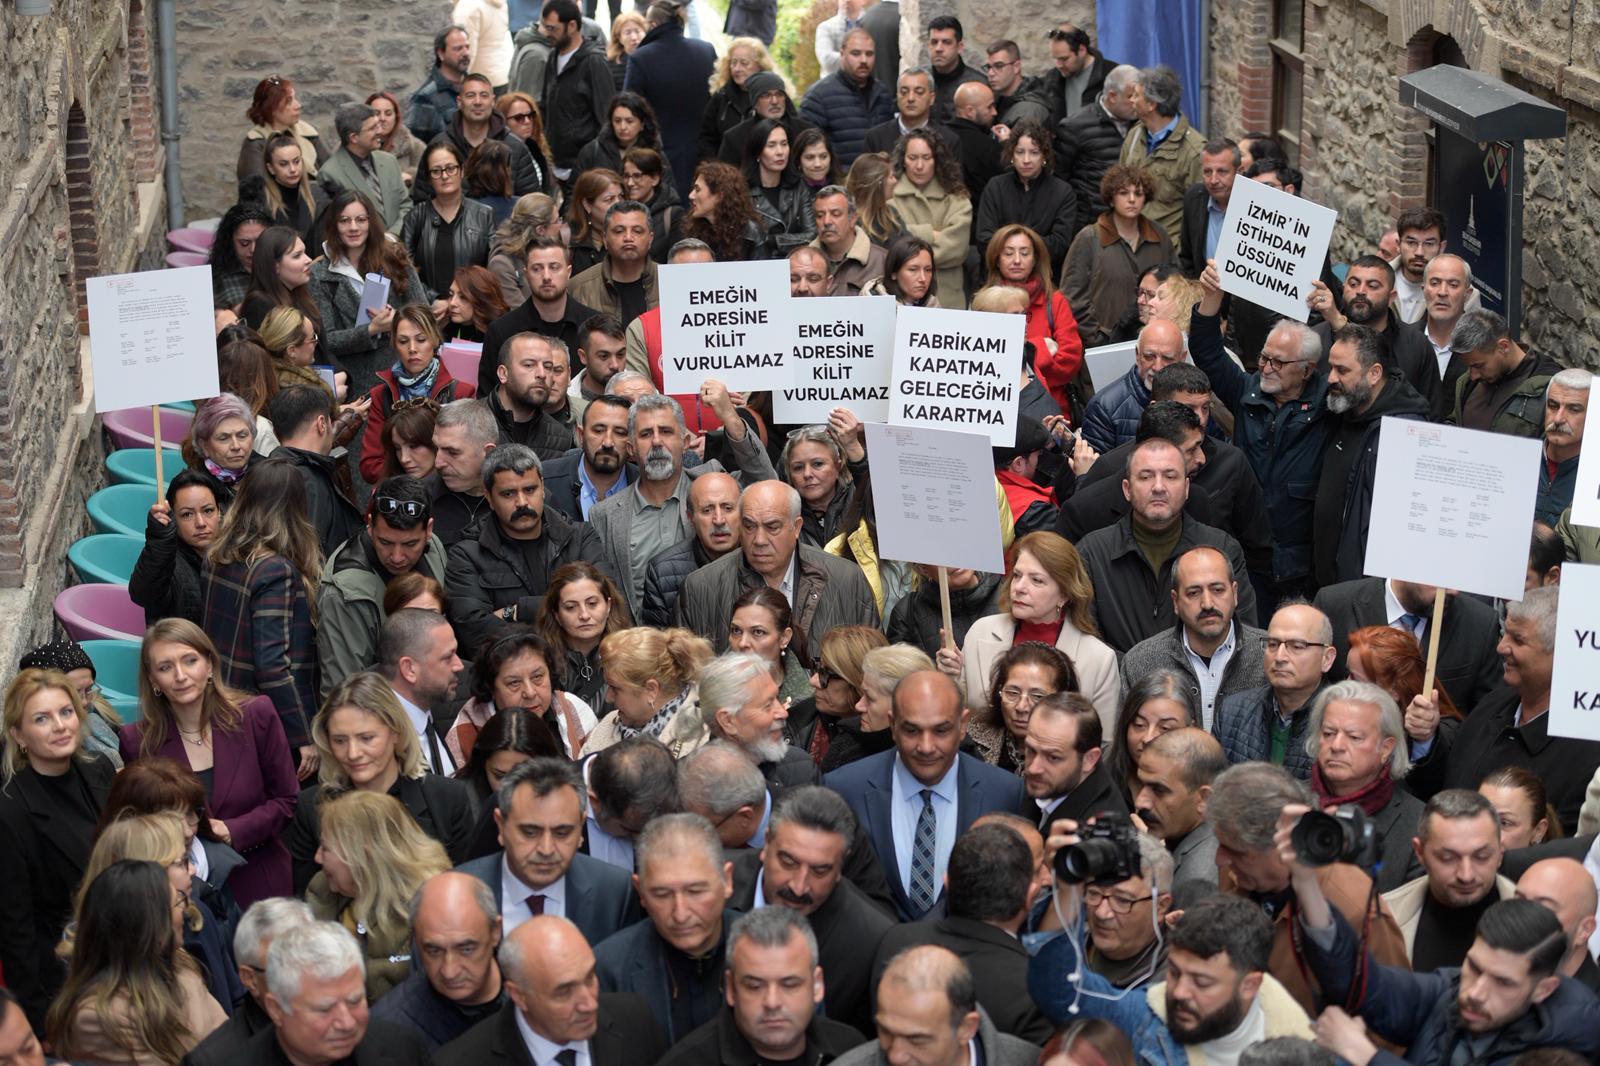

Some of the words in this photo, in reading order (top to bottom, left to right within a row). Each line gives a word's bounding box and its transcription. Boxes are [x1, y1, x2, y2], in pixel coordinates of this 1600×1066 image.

[1236, 217, 1307, 259] İSTİHDAM
[1236, 239, 1296, 277] ÜSSÜNE
[1224, 259, 1299, 300] DOKUNMA
[689, 285, 757, 305] EMEĞİN
[681, 307, 769, 328] ADRESİNE
[704, 330, 746, 348] KİLİT
[798, 320, 864, 338] EMEĞİN
[792, 341, 875, 359] ADRESİNE
[909, 331, 1006, 354] FABRİKAMI
[673, 352, 784, 371] VURULAMAZ
[813, 362, 853, 380] KİLİT
[909, 356, 1001, 380] KAPATMA,
[783, 386, 889, 401] VURULAMAZ
[899, 379, 1012, 402] GELECEĞİMİ
[903, 403, 1005, 425] KARARTMA
